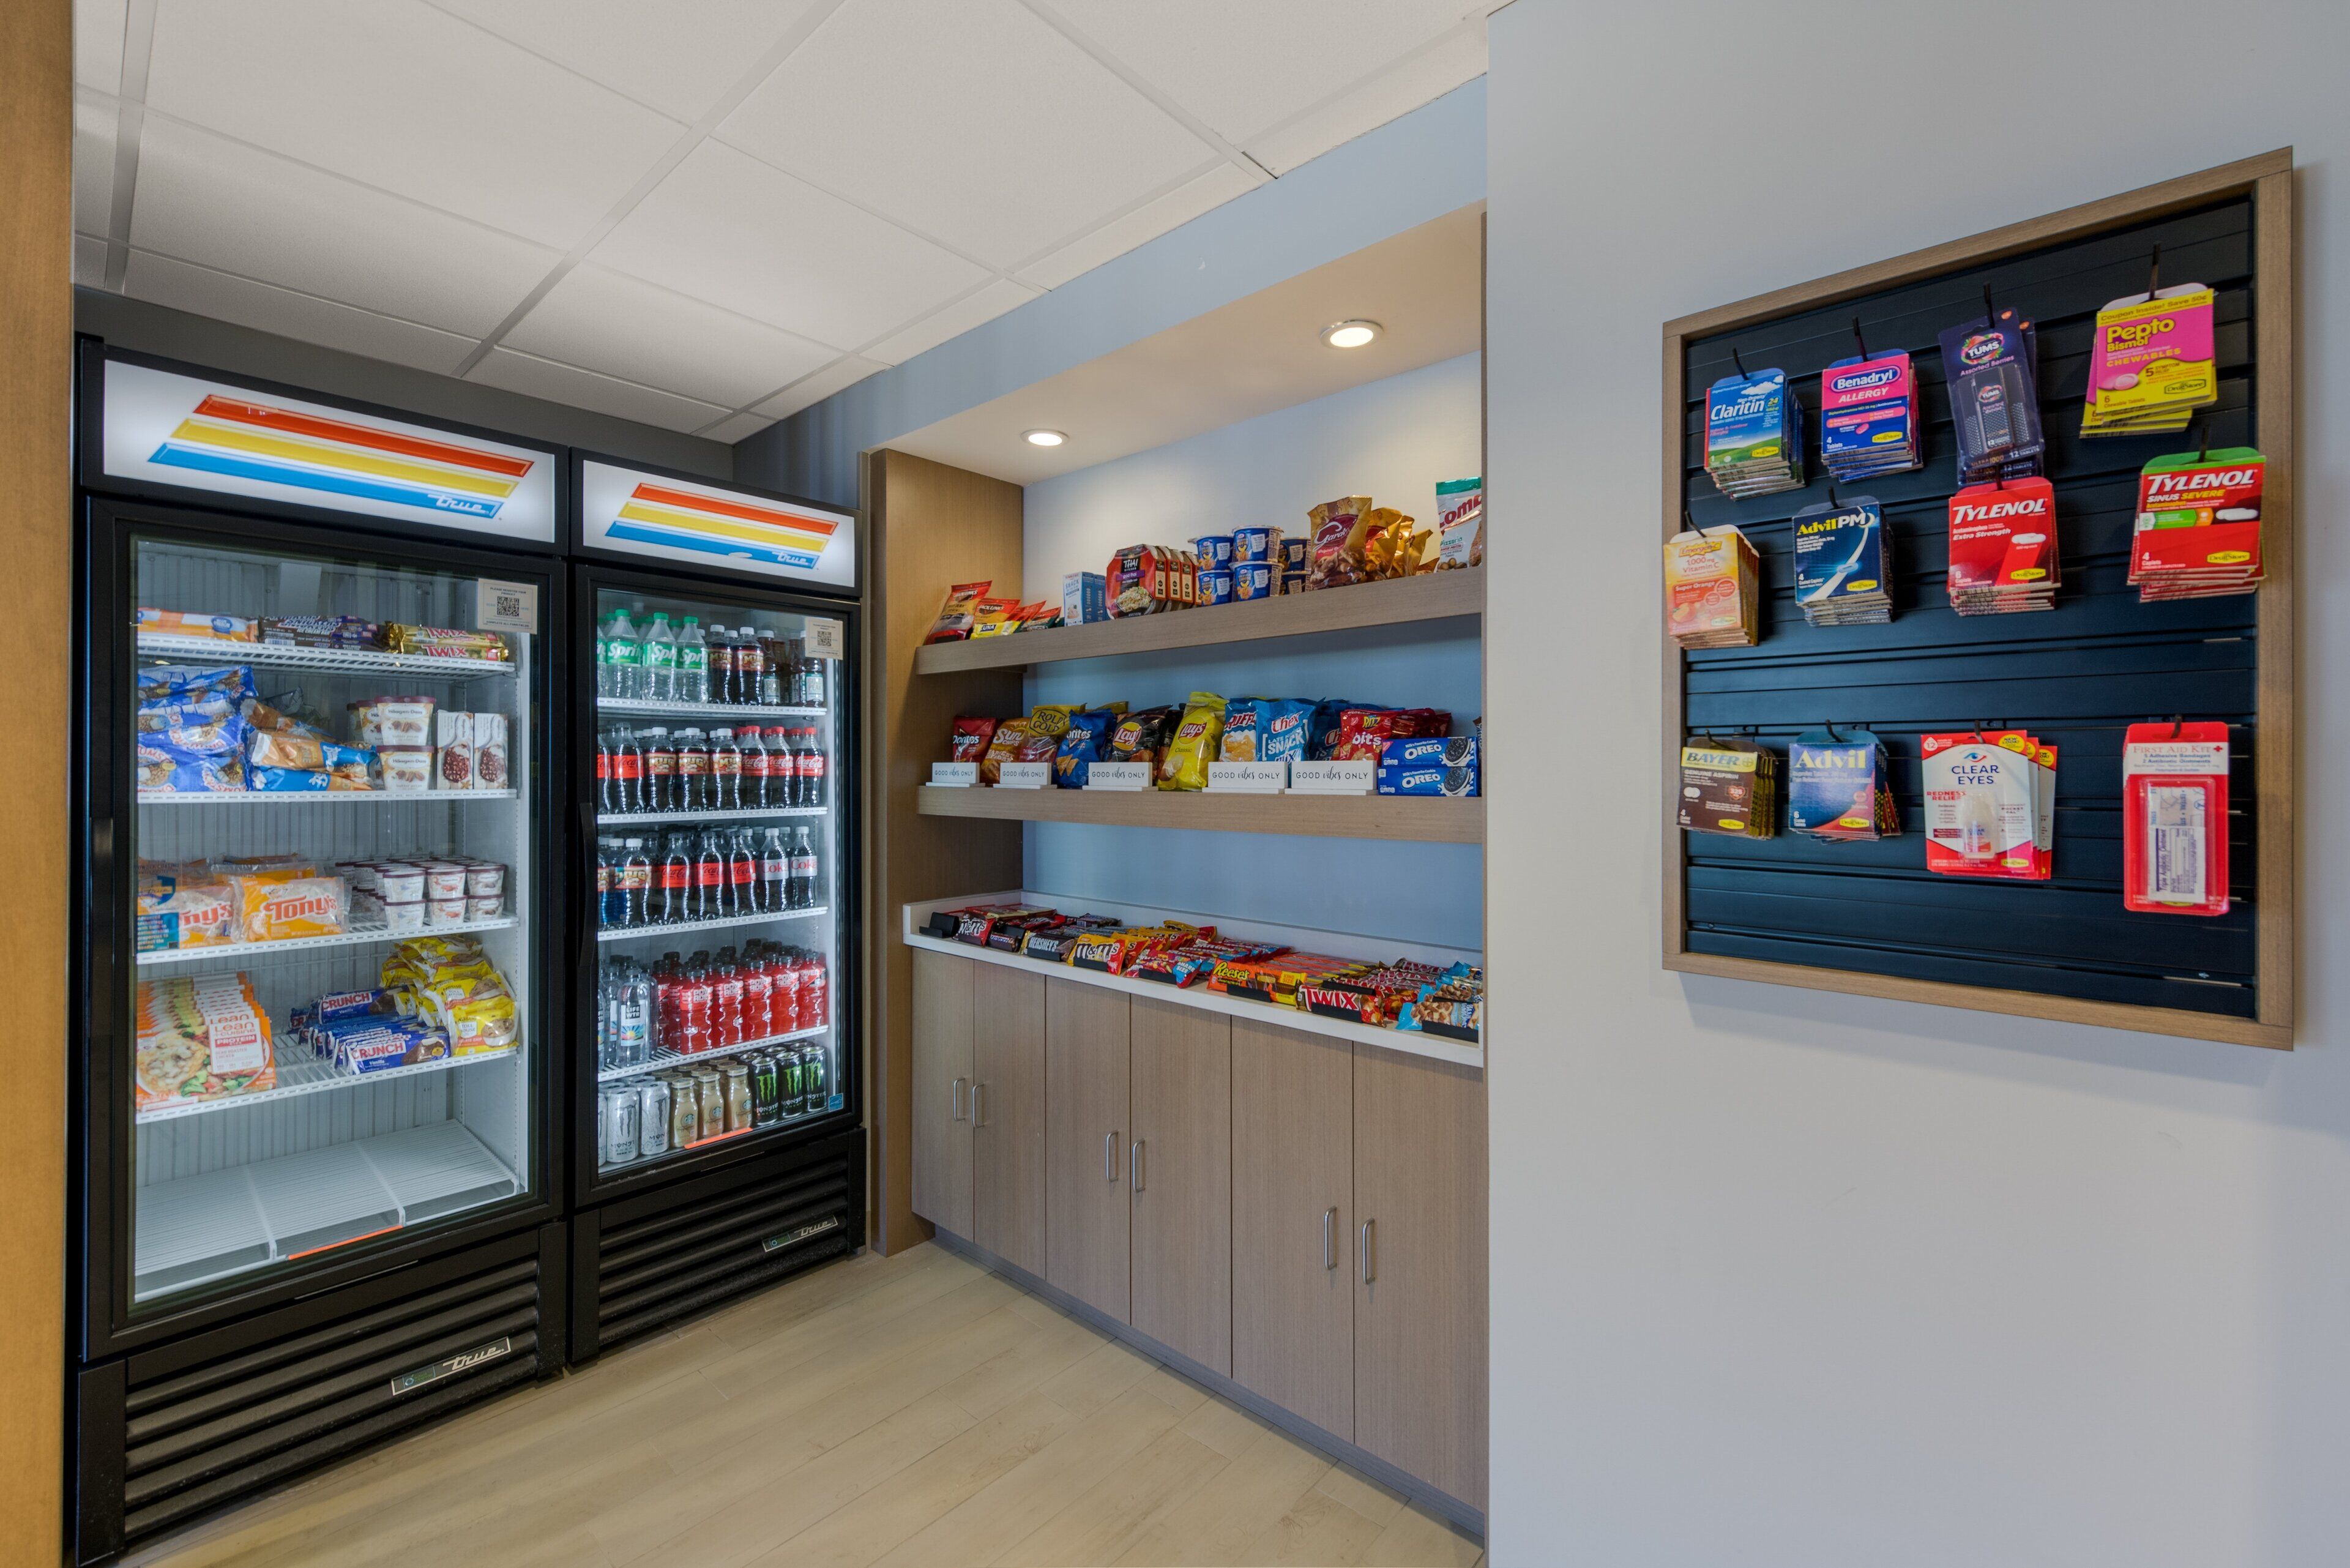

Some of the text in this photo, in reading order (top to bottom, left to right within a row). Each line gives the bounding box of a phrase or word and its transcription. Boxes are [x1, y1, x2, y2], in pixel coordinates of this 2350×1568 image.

[2101, 297, 2189, 322] Coupon Inside! Save
[2106, 318, 2175, 343] Pepto
[1968, 341, 1999, 357] TUMS
[2106, 336, 2150, 353] Bismol
[2106, 348, 2182, 368] CHEWABLES
[1960, 355, 2015, 376] Assorted Berries
[2145, 367, 2154, 377] 5
[1837, 370, 1893, 389] Benadryl
[1838, 387, 1889, 403] ALLERGY
[1982, 389, 2000, 398] TUMS
[1711, 400, 1764, 420] Claritin
[2020, 447, 2040, 456] TABLETS
[2148, 469, 2255, 495] TYLENOL
[2146, 490, 2226, 503] SINUS SEVERE
[428, 494, 489, 514] true
[1953, 498, 2047, 525] TYLENOL
[1796, 512, 1867, 536] Advil PM
[1953, 528, 2011, 541] Extra Strength
[772, 551, 810, 566] true
[1687, 557, 1707, 566] 1000
[2142, 552, 2149, 561] 4
[1124, 559, 1138, 569] THAI
[1684, 564, 1712, 573] Vitamin
[1955, 570, 1961, 579] 6
[1676, 583, 1693, 592] Super
[422, 644, 468, 657] TWIX
[1037, 711, 1067, 725] ROLD
[1271, 711, 1304, 733] Chex
[1362, 716, 1381, 729] RITZ
[1033, 720, 1061, 733] GOLD
[1179, 723, 1206, 739] Lay's
[1067, 729, 1092, 740] oritos
[1352, 733, 1382, 745] bits
[1267, 733, 1305, 755] SNACK
[1404, 744, 1442, 760] OREO
[1687, 752, 1740, 766] BAYER
[1794, 750, 1866, 769] Advil
[1112, 767, 1126, 779] vibes
[1238, 766, 1255, 780] vibes
[1322, 766, 1341, 780] vibes
[1713, 771, 1739, 780] ASPIRIN
[1952, 765, 2000, 775] CLEAR
[1402, 774, 1441, 788] OREO
[1958, 775, 1994, 785] EYES
[791, 859, 818, 870] Coke
[263, 895, 337, 923] Tony's
[1028, 936, 1059, 952] HERSHEY'S
[1213, 961, 1250, 980] Reese's
[322, 993, 372, 1010] CRUNCH
[1299, 984, 1359, 1012] TWIX
[216, 1034, 255, 1045] PROTEIN
[351, 1042, 406, 1060] CRUNCH
[442, 1346, 504, 1370] true
